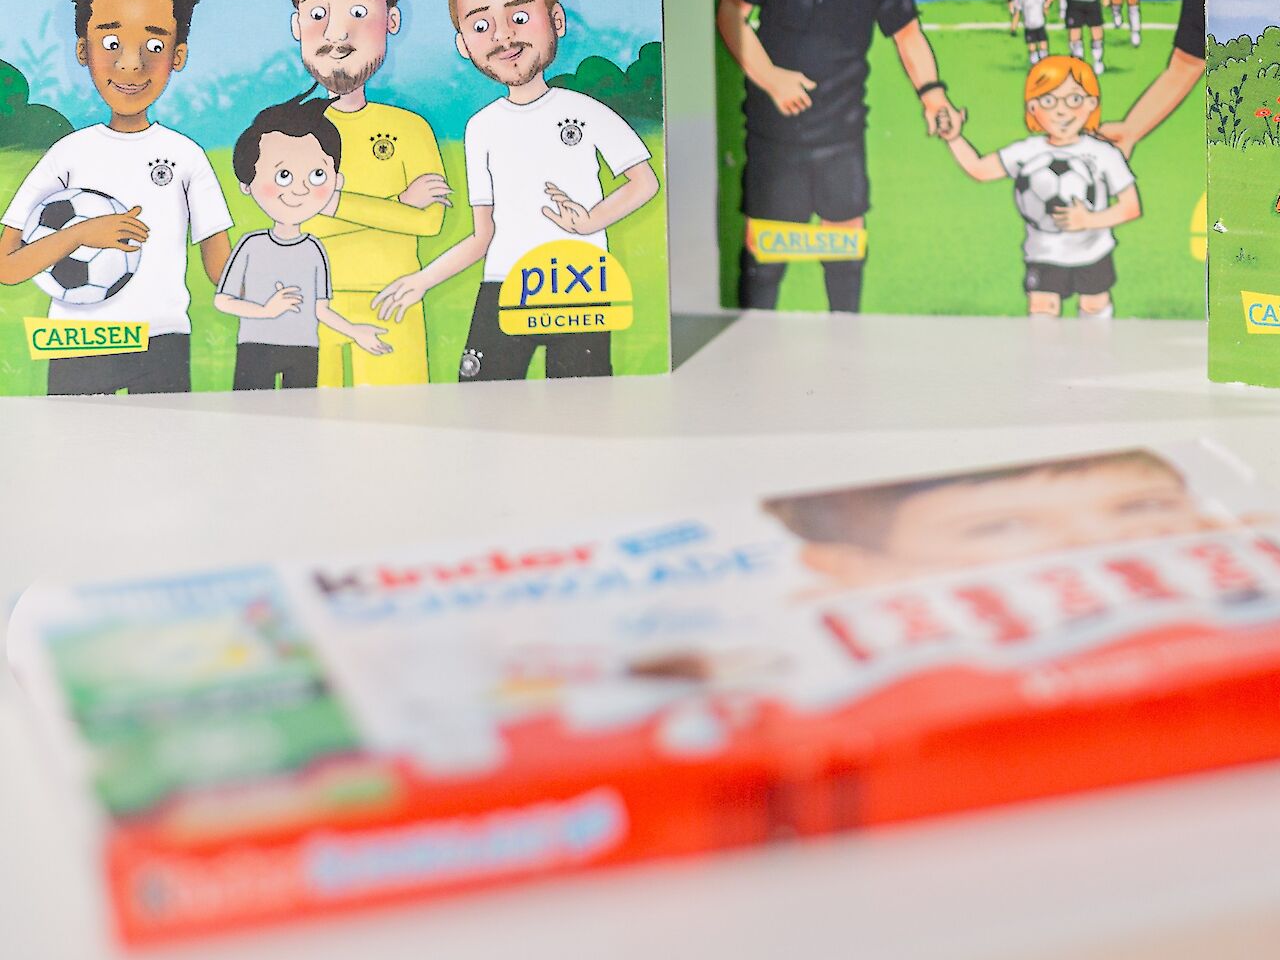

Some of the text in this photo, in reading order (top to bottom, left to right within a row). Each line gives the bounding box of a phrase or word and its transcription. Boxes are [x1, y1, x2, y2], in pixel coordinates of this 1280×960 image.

[757, 230, 858, 255] CARLSEN
[520, 256, 608, 307] pixi
[526, 311, 606, 329] BÜCHER
[32, 325, 142, 350] CARLSEN
